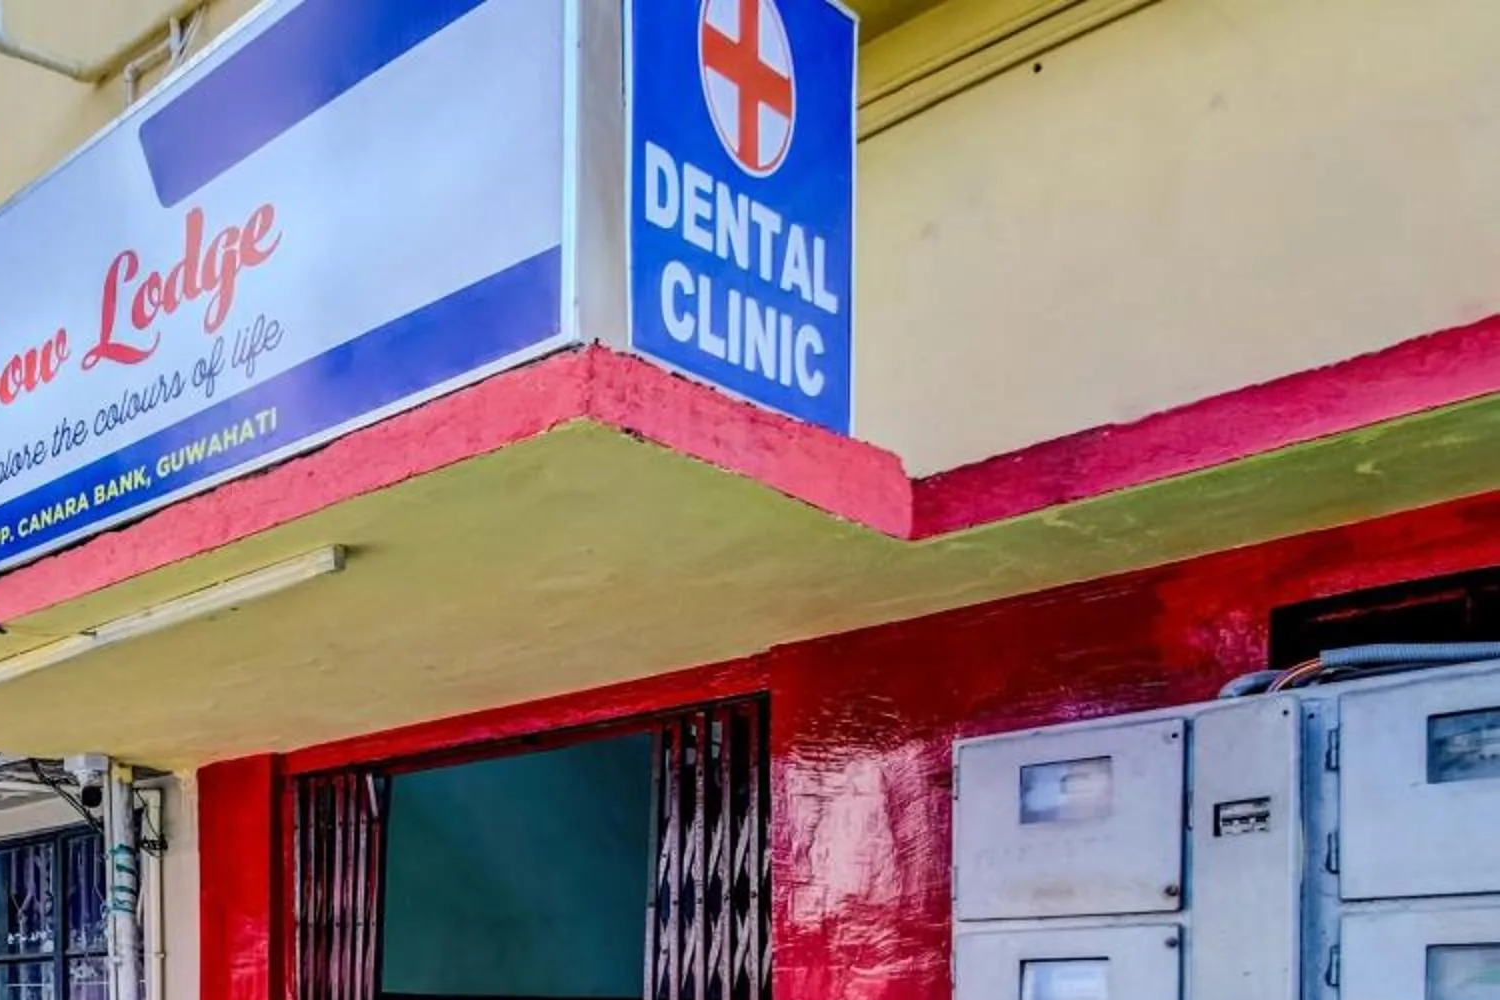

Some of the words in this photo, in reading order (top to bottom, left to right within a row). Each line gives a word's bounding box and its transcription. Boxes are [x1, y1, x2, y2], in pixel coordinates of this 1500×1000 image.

[81, 203, 283, 371] Lodge
[644, 140, 838, 315] DENTAL
[52, 417, 88, 456] the
[93, 374, 186, 437] colours
[191, 334, 224, 399] of
[231, 313, 285, 378] life
[660, 260, 825, 397] CLINIC
[17, 492, 90, 538] CANARA
[93, 466, 152, 505] BANK,
[156, 407, 278, 478] GUWAHATI
